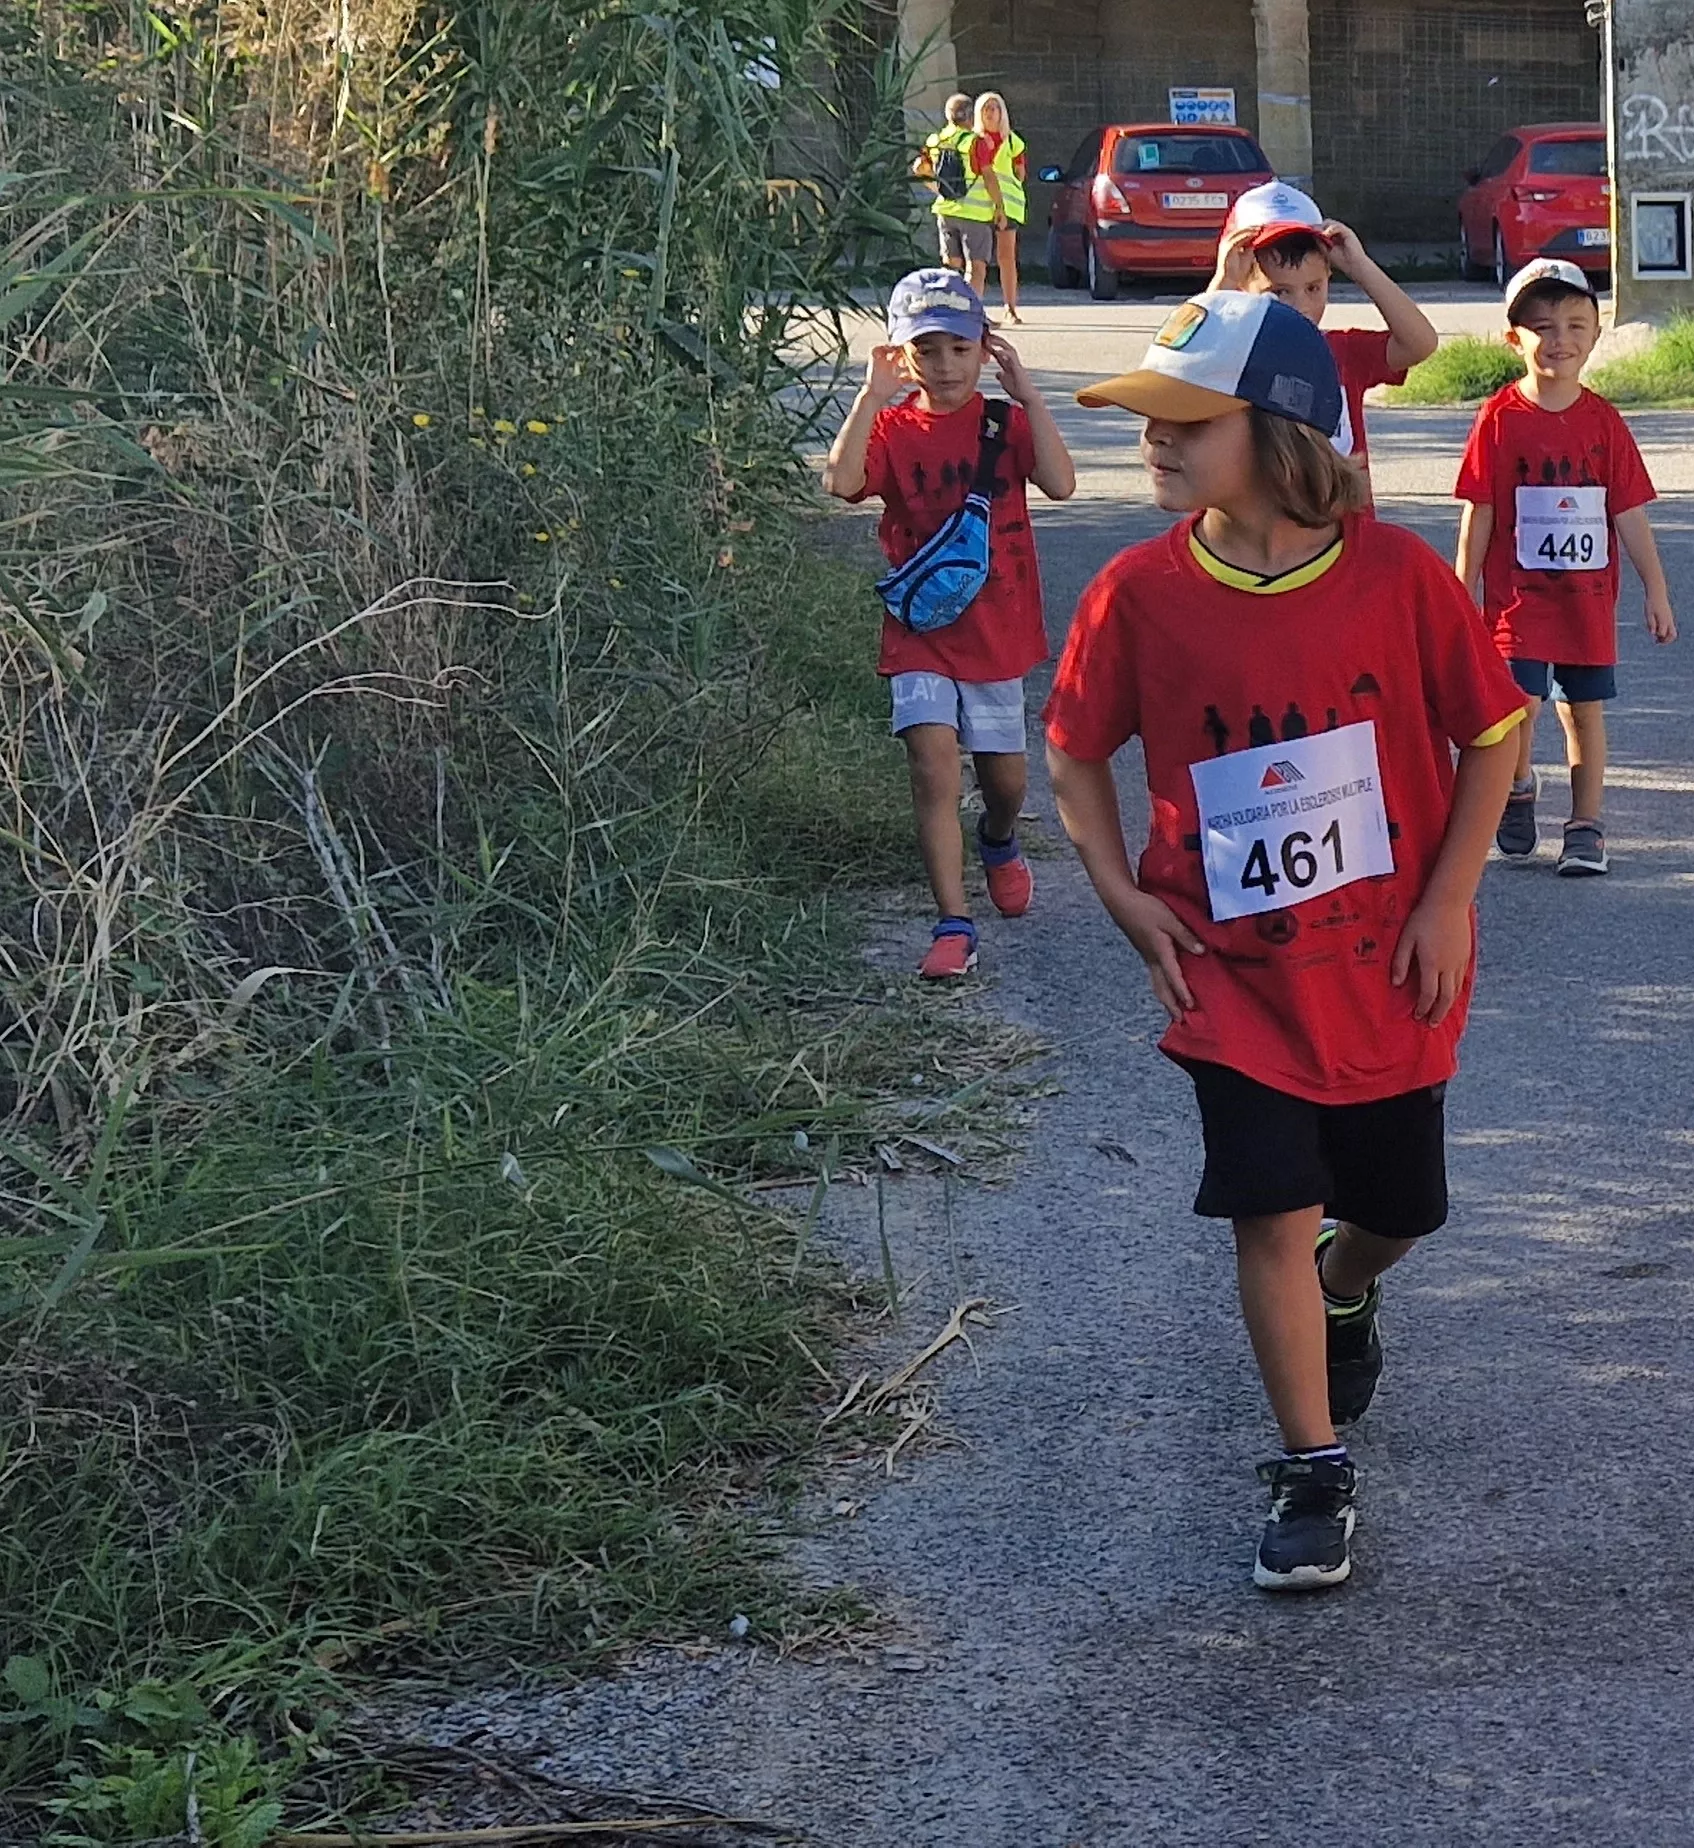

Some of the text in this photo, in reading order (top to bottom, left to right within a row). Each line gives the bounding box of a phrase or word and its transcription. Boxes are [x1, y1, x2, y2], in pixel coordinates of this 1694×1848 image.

[1537, 532, 1594, 563] 449
[1270, 799, 1290, 819] POR
[1289, 798, 1301, 816] LA
[1240, 818, 1344, 897] 461
